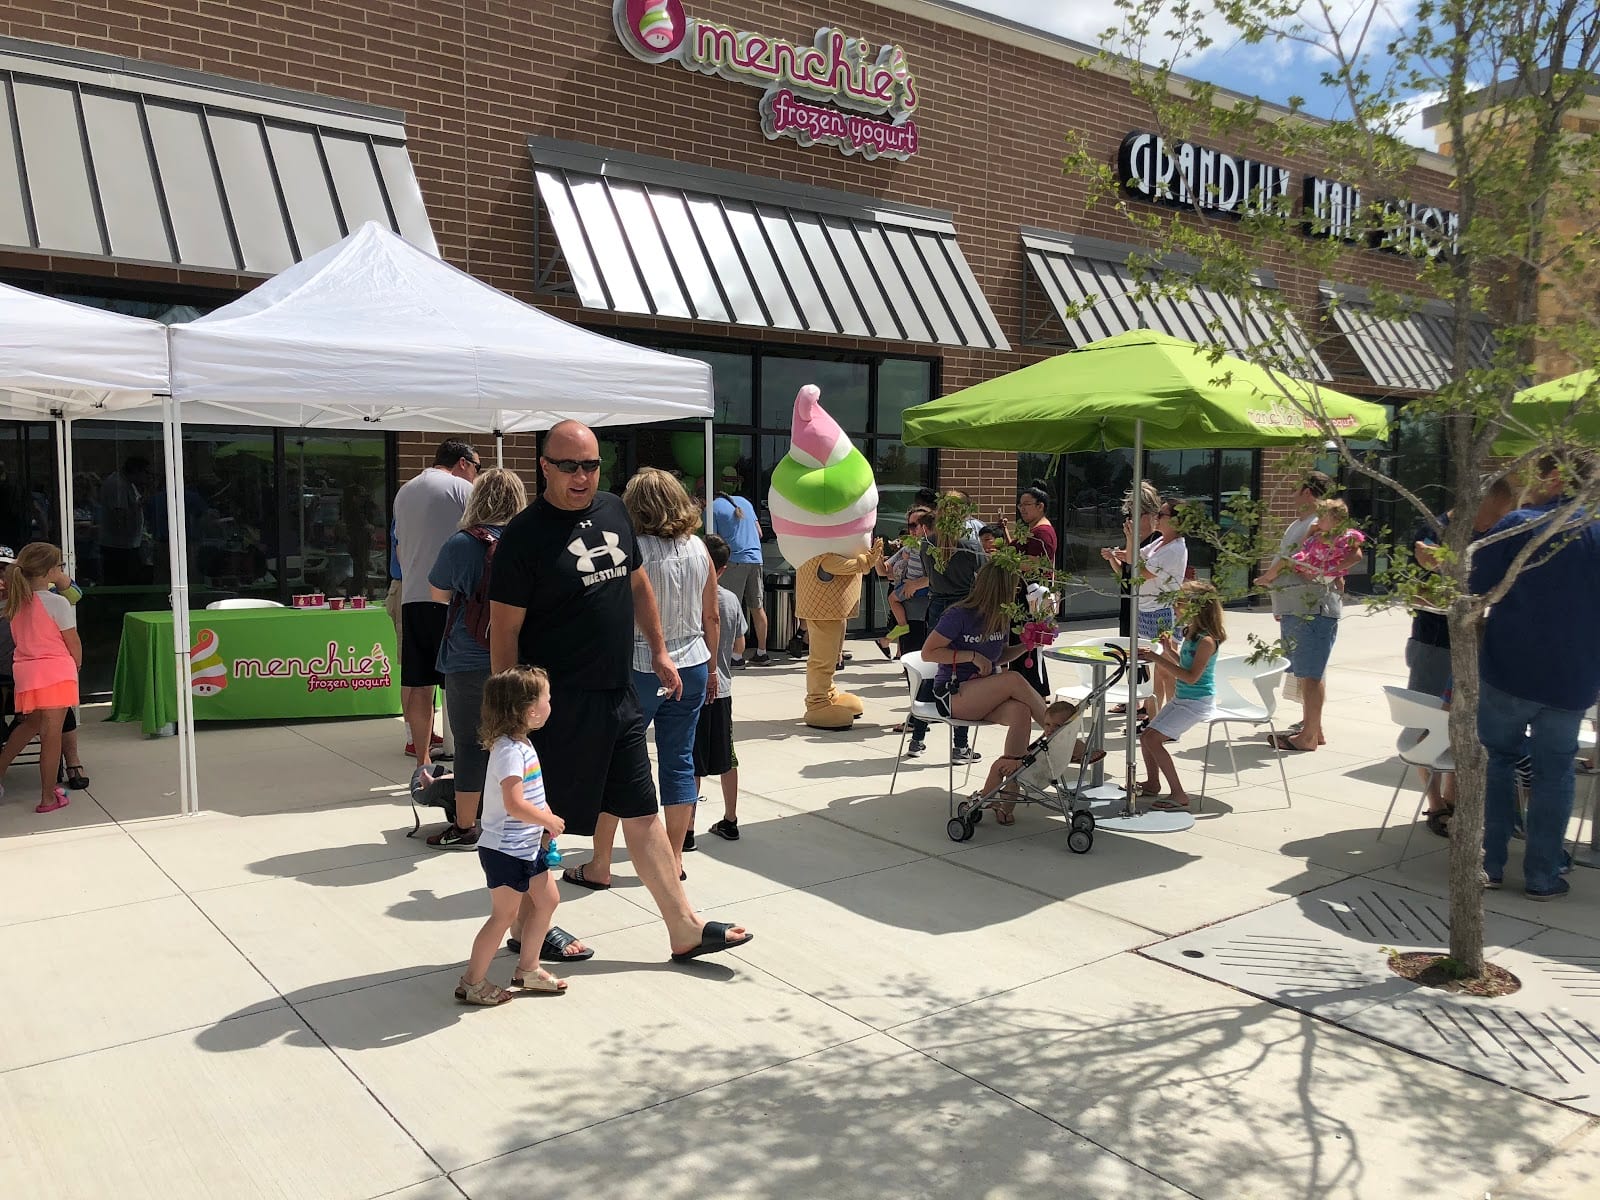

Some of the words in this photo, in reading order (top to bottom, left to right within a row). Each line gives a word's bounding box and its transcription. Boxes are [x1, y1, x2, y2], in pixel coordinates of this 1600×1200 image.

[695, 22, 917, 110] menchie's
[775, 93, 845, 136] frozen
[851, 120, 915, 151] yogurt
[234, 641, 390, 677] menchie's
[308, 675, 349, 692] frozen
[351, 673, 391, 691] yogurt
